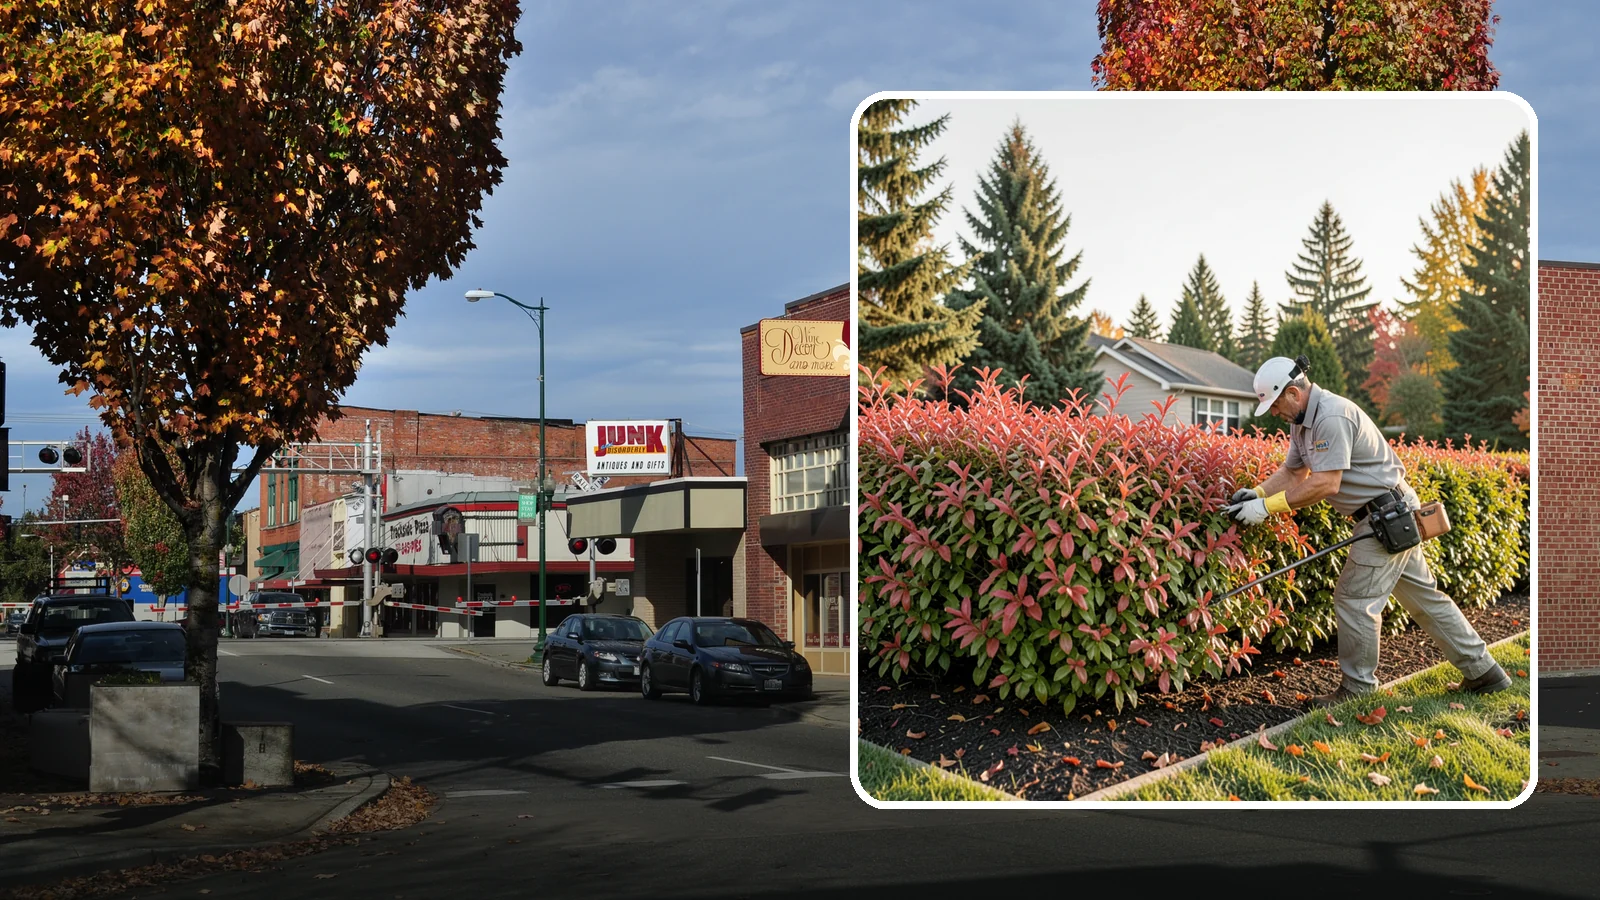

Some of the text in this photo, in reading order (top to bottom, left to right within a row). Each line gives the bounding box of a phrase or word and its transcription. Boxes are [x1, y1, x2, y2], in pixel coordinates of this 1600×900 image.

[764, 327, 831, 366] Decor
[595, 425, 664, 457] JUNK
[607, 446, 646, 454] DISORDERLY
[596, 460, 666, 470] ANTIQUES AND GIFTS
